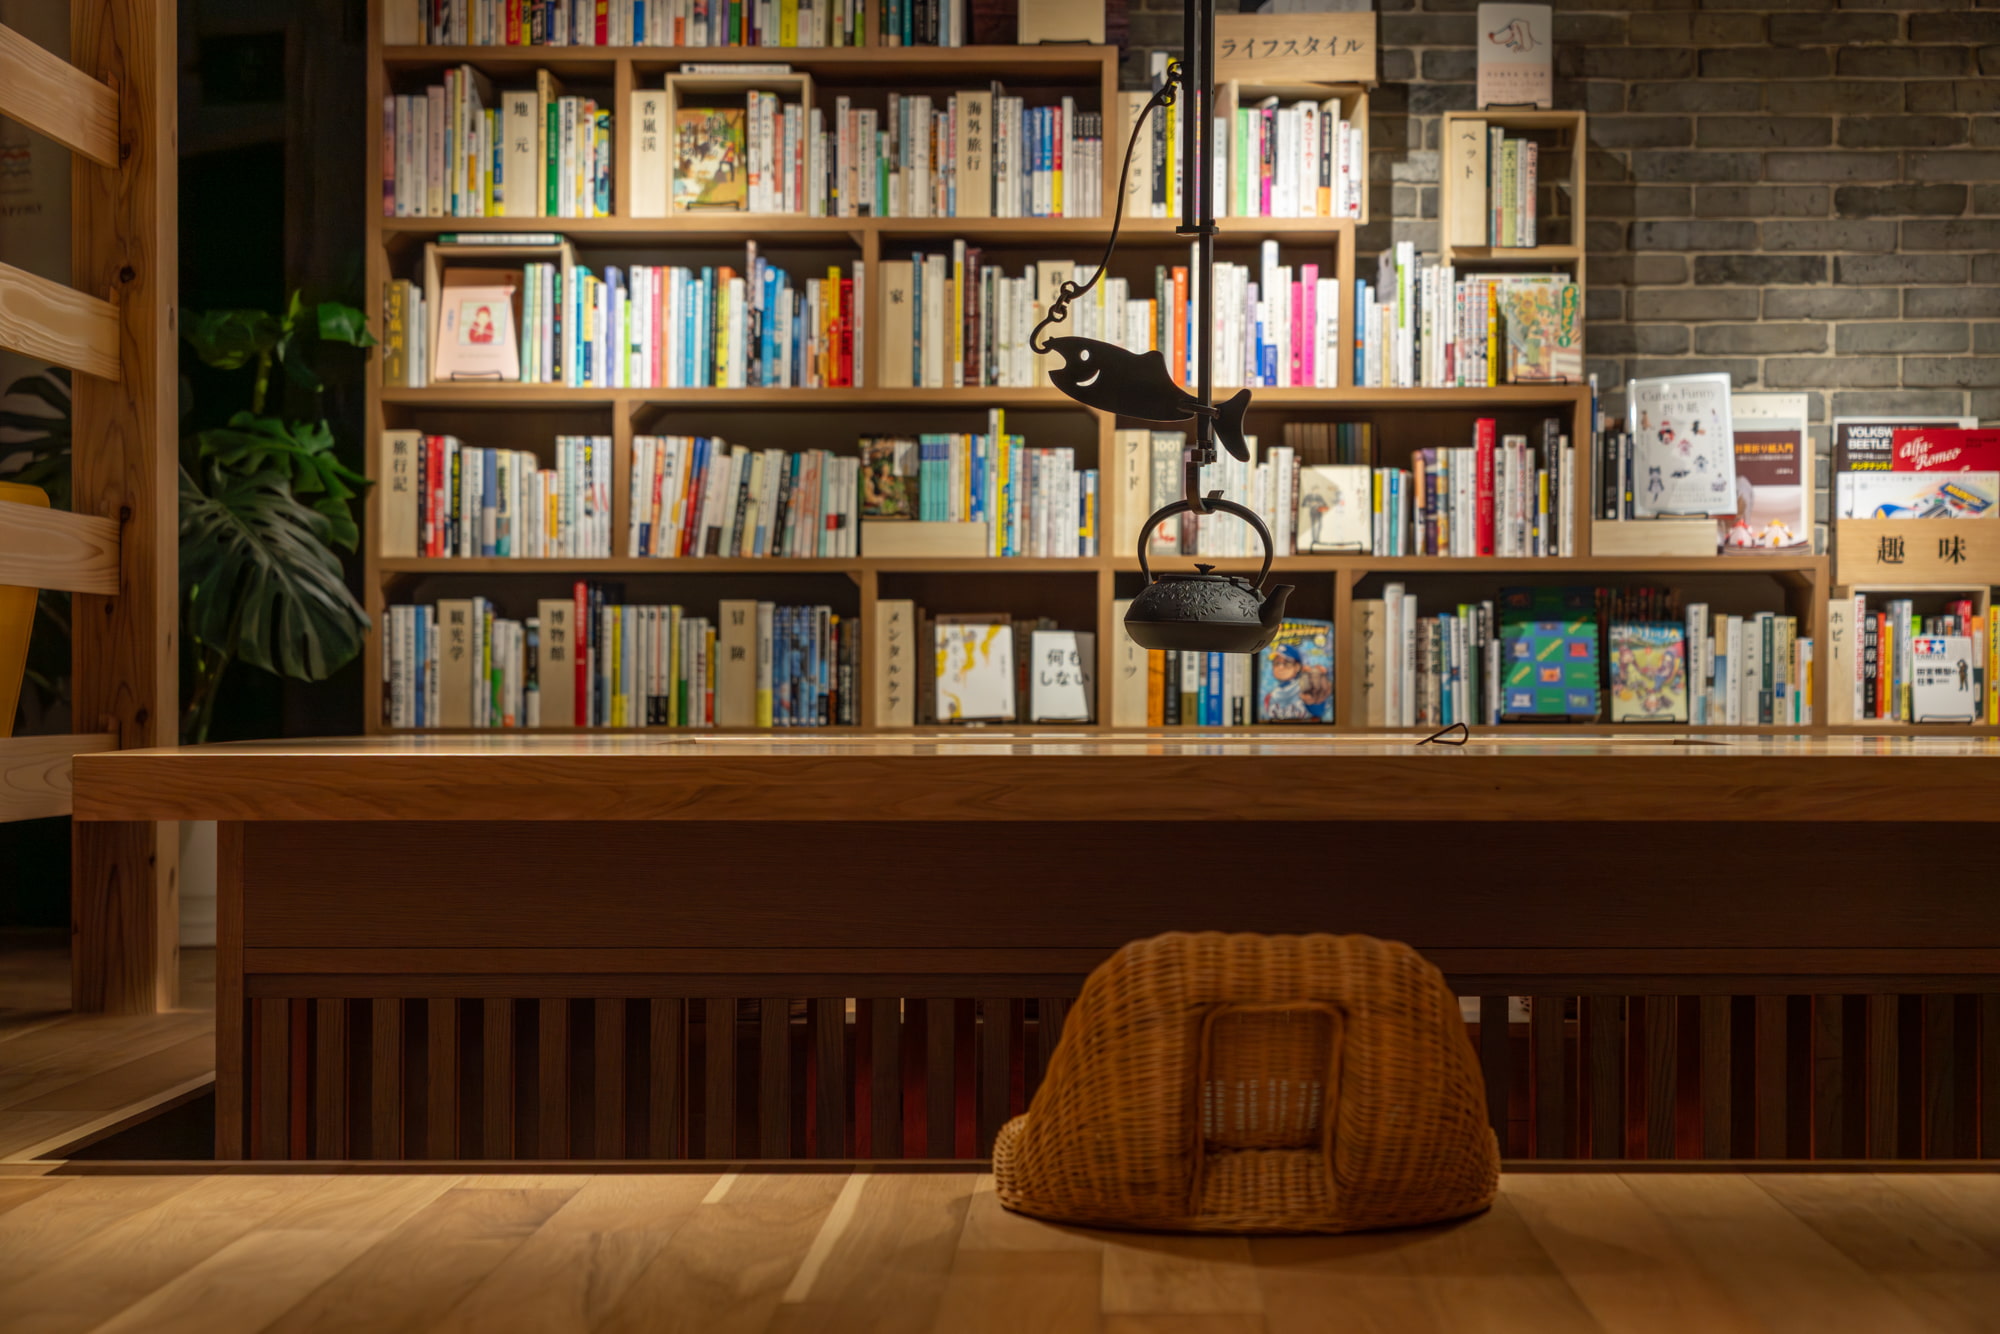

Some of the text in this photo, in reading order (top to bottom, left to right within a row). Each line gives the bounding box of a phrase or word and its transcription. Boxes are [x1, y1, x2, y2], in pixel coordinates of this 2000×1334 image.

[1221, 36, 1365, 57] ライフスタイル
[514, 101, 529, 153] 地元
[966, 101, 982, 172] 海外旅行
[1462, 131, 1477, 180] ペット
[392, 439, 408, 493] 旅行記
[1127, 441, 1140, 491] フード
[1153, 440, 1181, 452] 1001
[1847, 438, 1890, 450] BEETLE
[1912, 447, 1962, 471] Romeo
[1876, 534, 1967, 565] 趣味
[449, 610, 465, 662] 観光学
[549, 610, 565, 662] 博物館
[1047, 648, 1083, 667] 何も
[1362, 610, 1375, 695] アウトドア
[1830, 611, 1843, 660] ホビー
[887, 611, 901, 711] メンタルケア
[1040, 670, 1090, 687] しない
